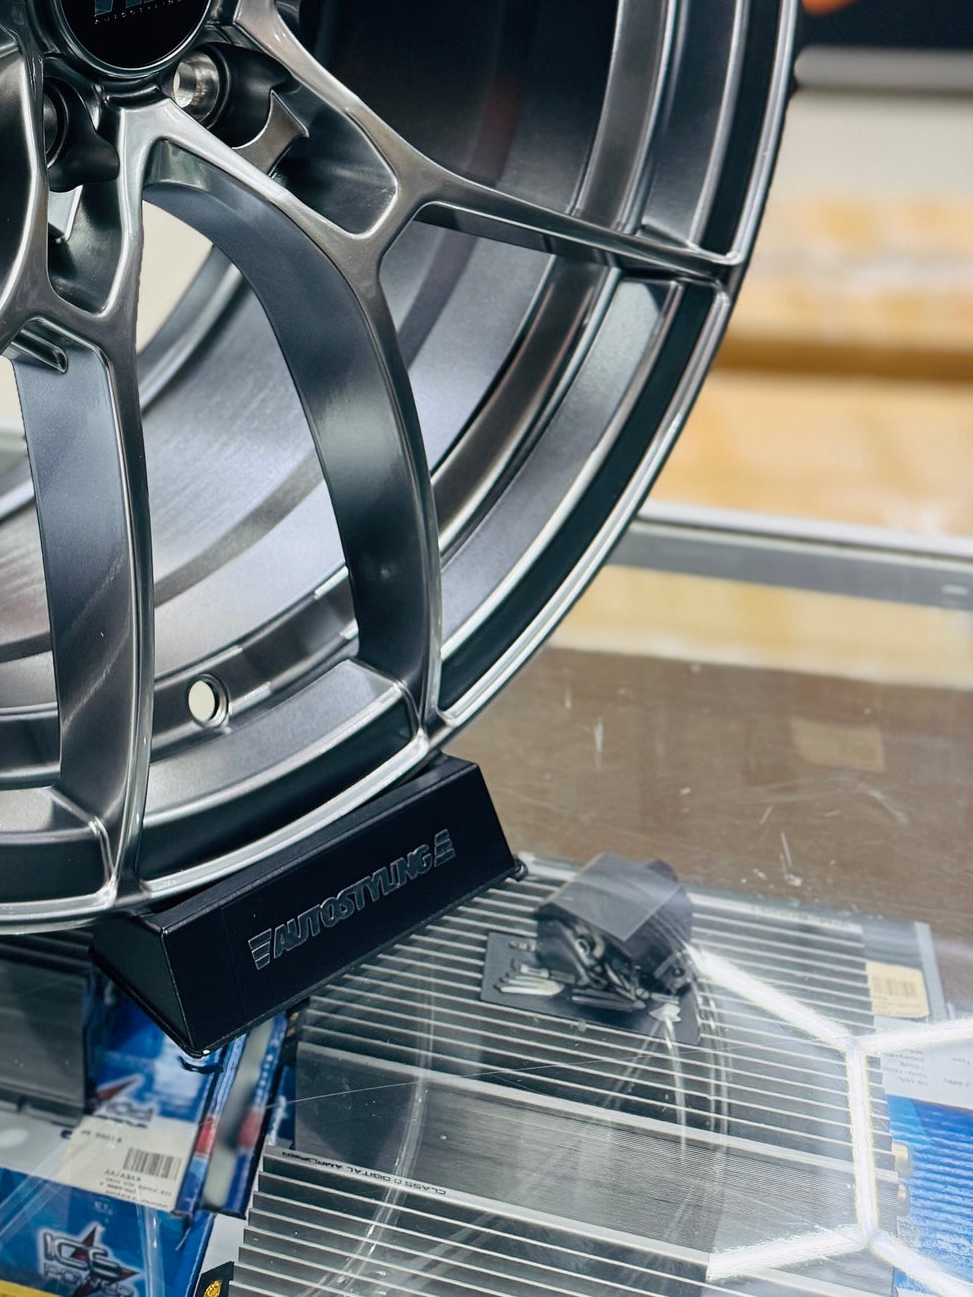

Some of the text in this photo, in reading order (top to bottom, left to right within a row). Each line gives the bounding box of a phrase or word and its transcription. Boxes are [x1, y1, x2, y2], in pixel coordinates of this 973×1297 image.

[273, 843, 433, 959] AUTOSTYLING
[346, 1165, 392, 1183] DIGITAL
[405, 1179, 447, 1196] CLASS
[43, 1231, 121, 1280] ICE
